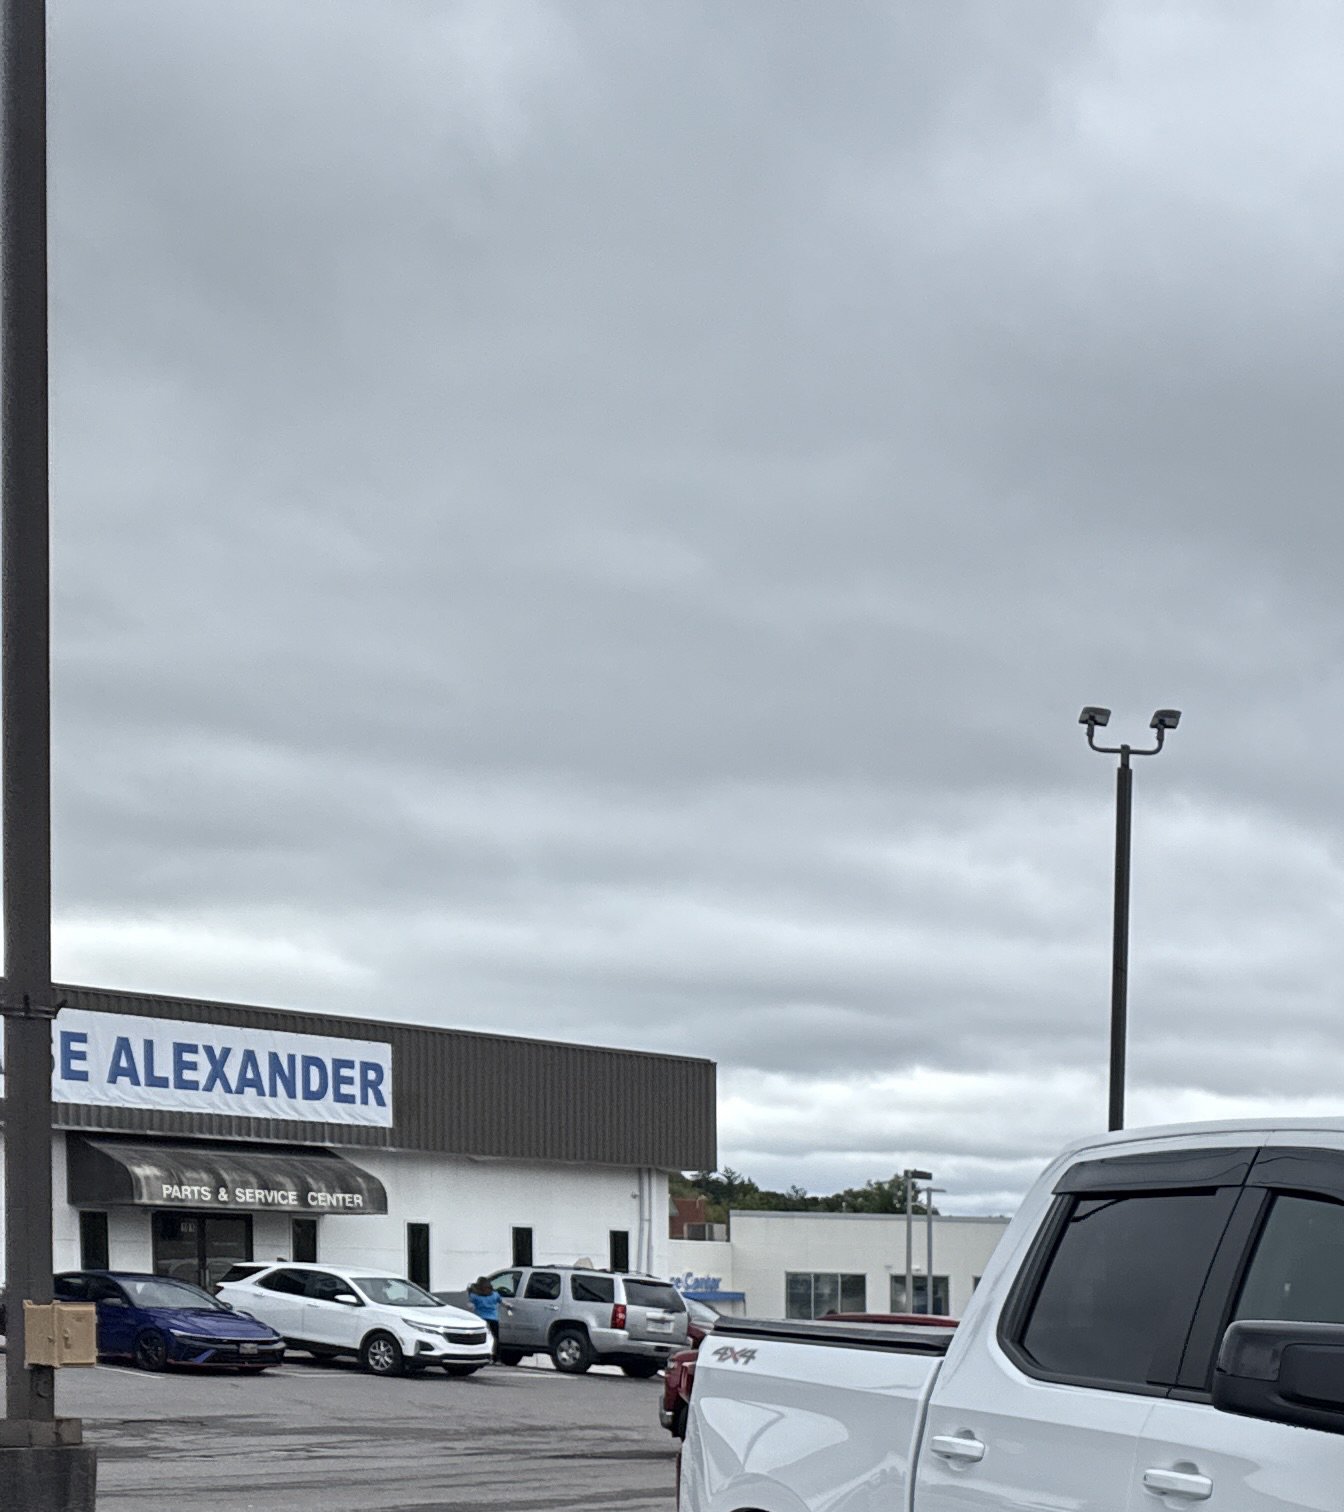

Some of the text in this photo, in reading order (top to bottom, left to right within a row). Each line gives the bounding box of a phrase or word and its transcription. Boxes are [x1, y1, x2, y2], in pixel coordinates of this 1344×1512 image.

[106, 1036, 387, 1108] ALEXANDER
[161, 1184, 364, 1208] PARTS & SERVICE CENTER
